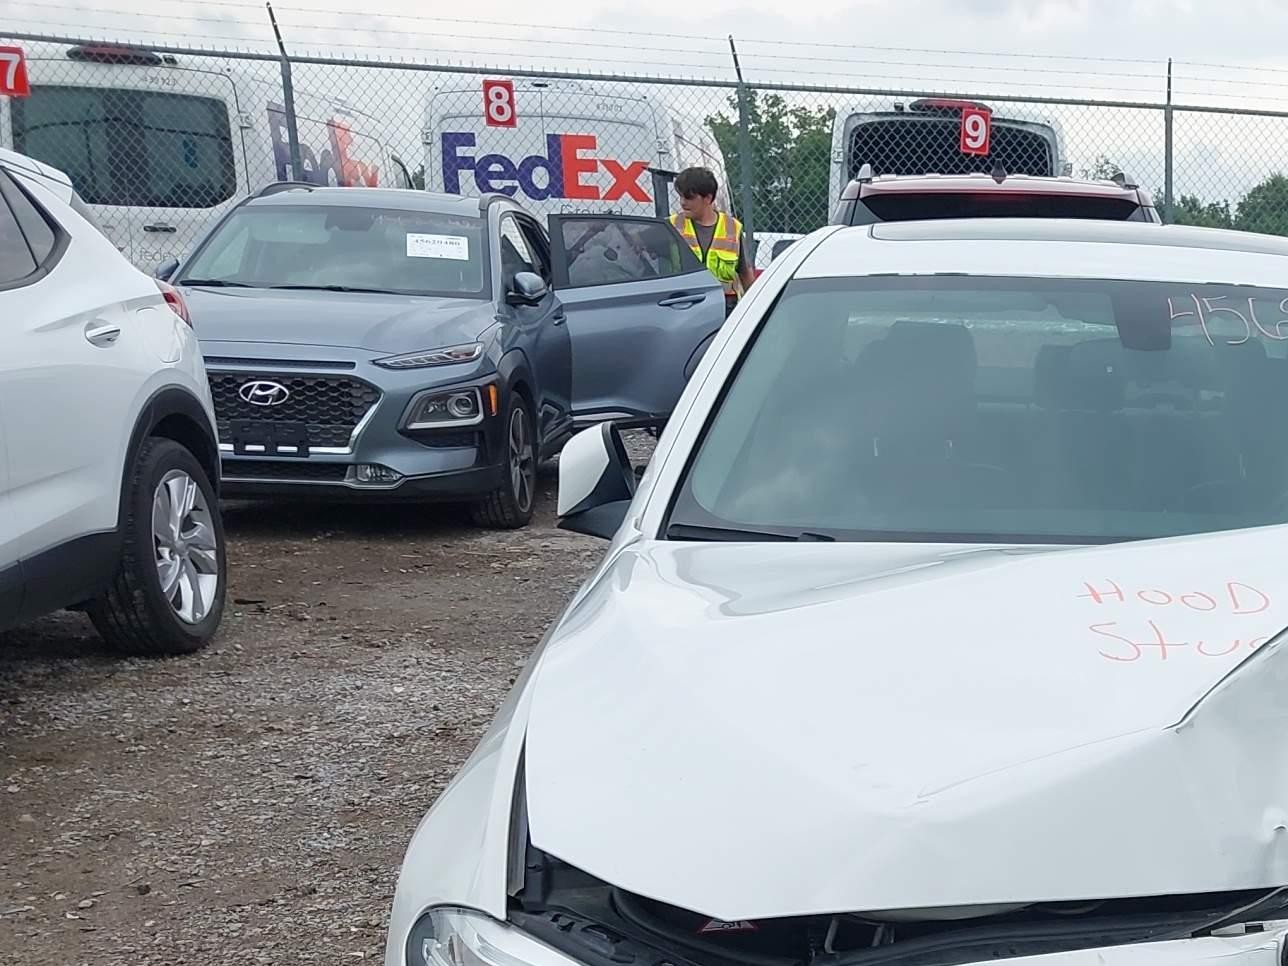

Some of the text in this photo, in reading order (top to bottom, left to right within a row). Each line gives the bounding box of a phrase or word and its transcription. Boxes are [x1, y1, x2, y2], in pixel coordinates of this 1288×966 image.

[0, 52, 20, 90] 7
[488, 86, 511, 122] 8
[965, 114, 986, 148] 9
[441, 132, 653, 202] FedEx
[1076, 578, 1270, 615] HOOD
